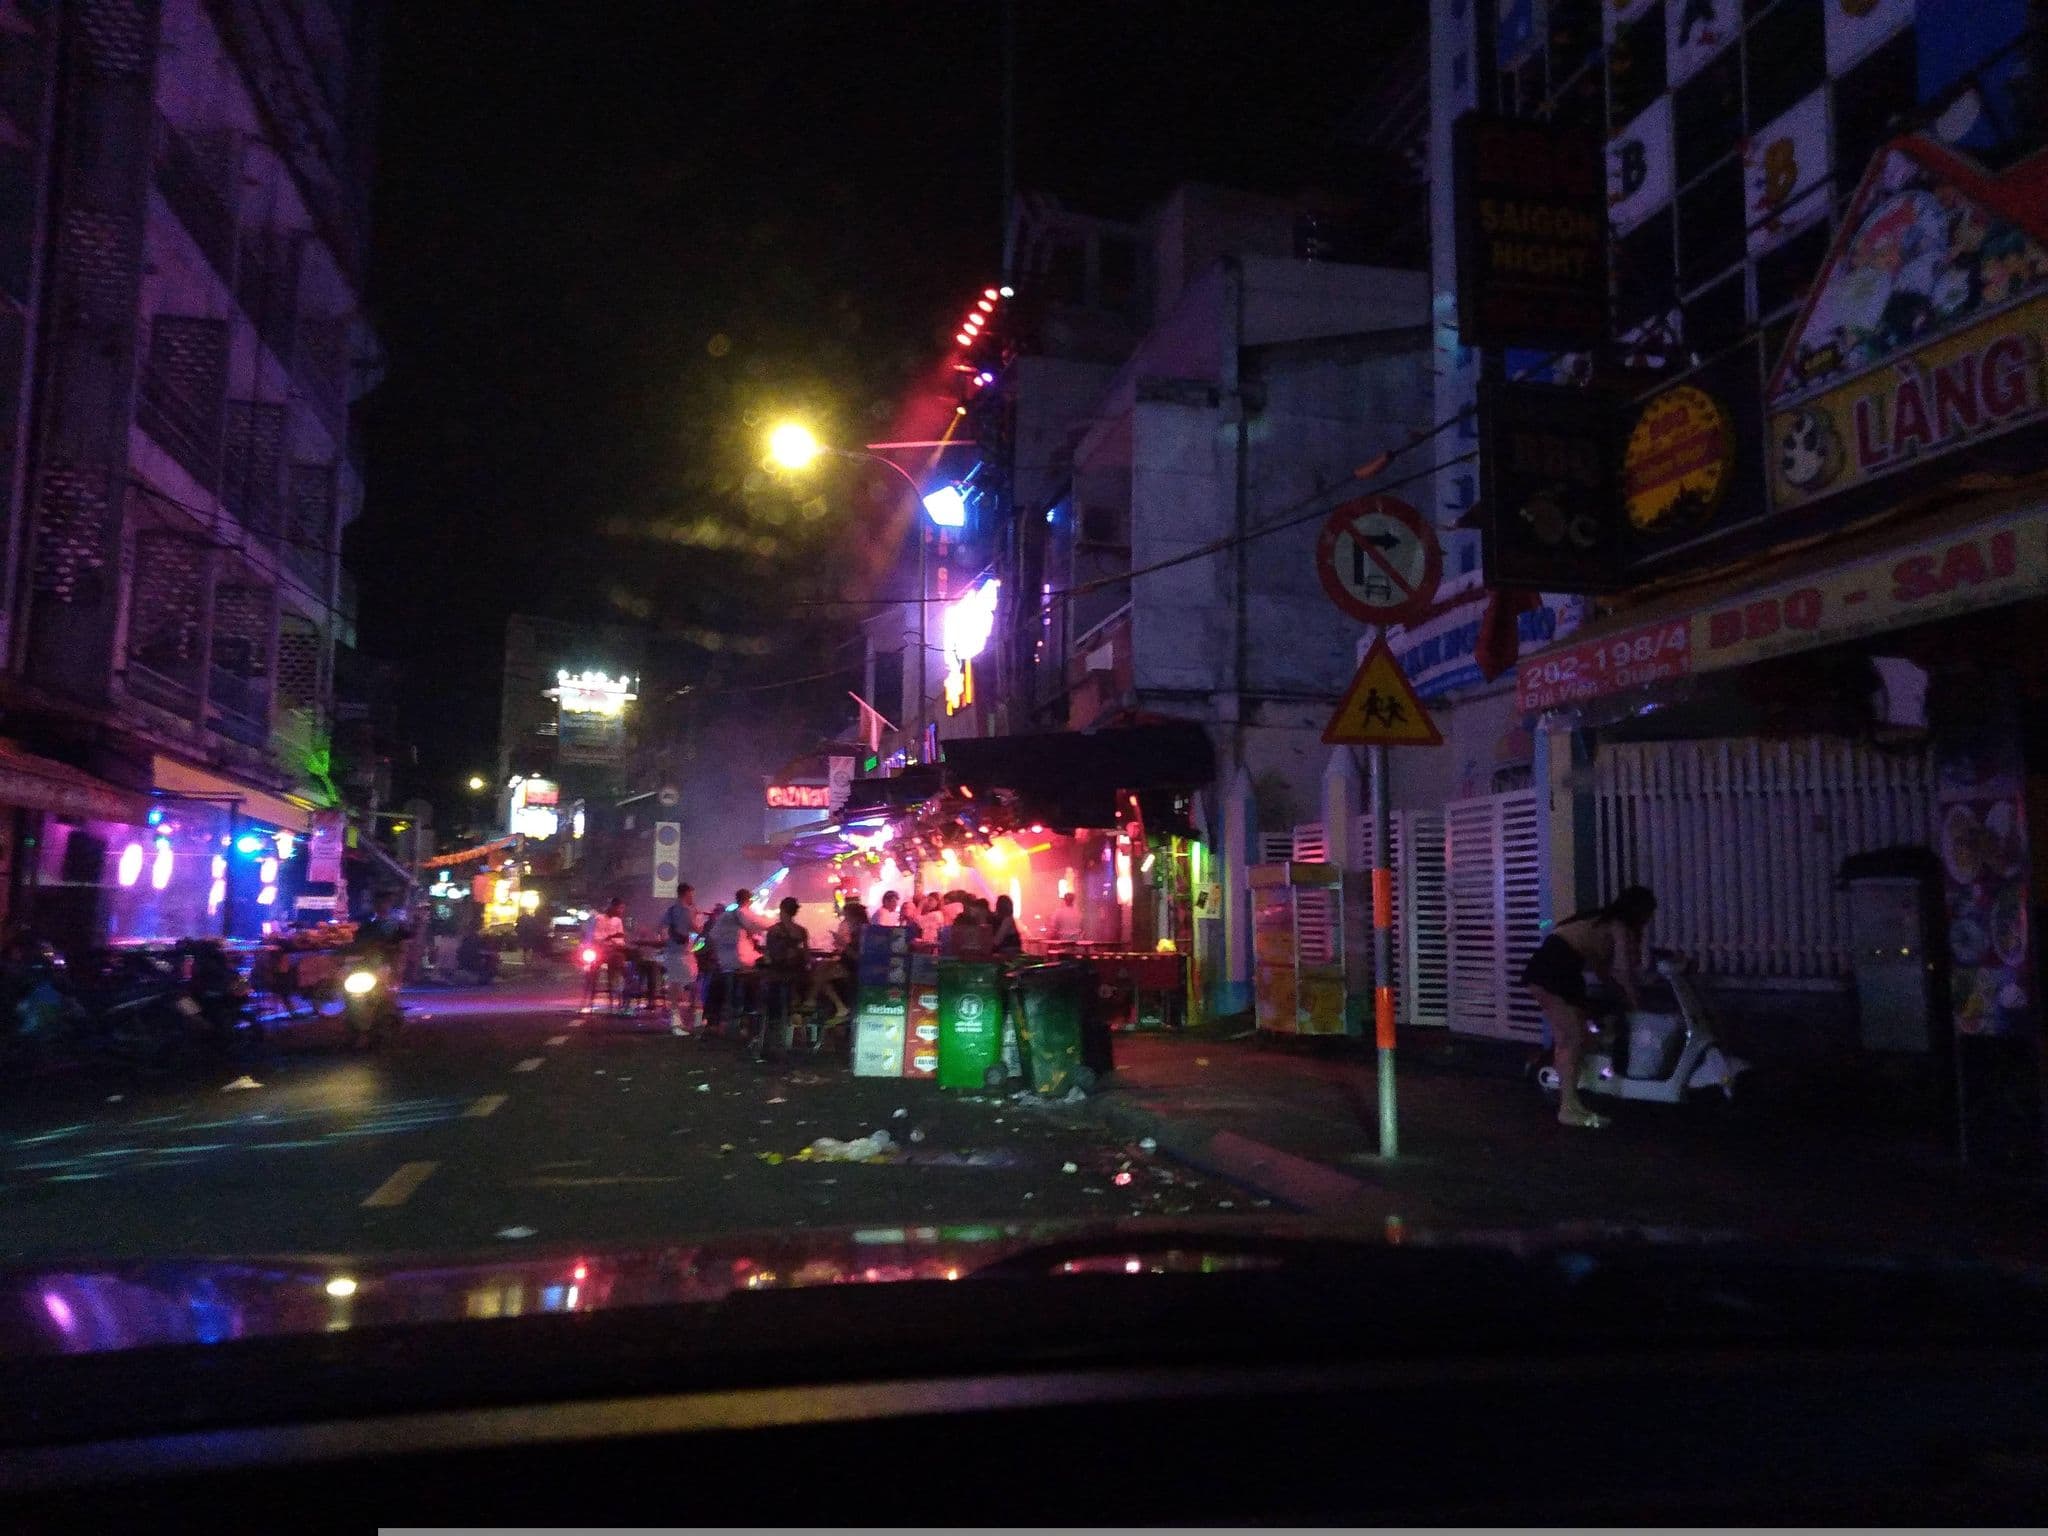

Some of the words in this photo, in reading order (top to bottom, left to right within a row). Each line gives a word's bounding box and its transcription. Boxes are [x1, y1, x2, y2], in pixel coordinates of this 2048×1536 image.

[1478, 197, 1599, 242] SAIGON
[1488, 240, 1590, 280] NIGHT
[1856, 335, 2028, 468] LÀNG
[1709, 589, 1823, 650] BBQ
[1526, 626, 1687, 689] 202-198/4
